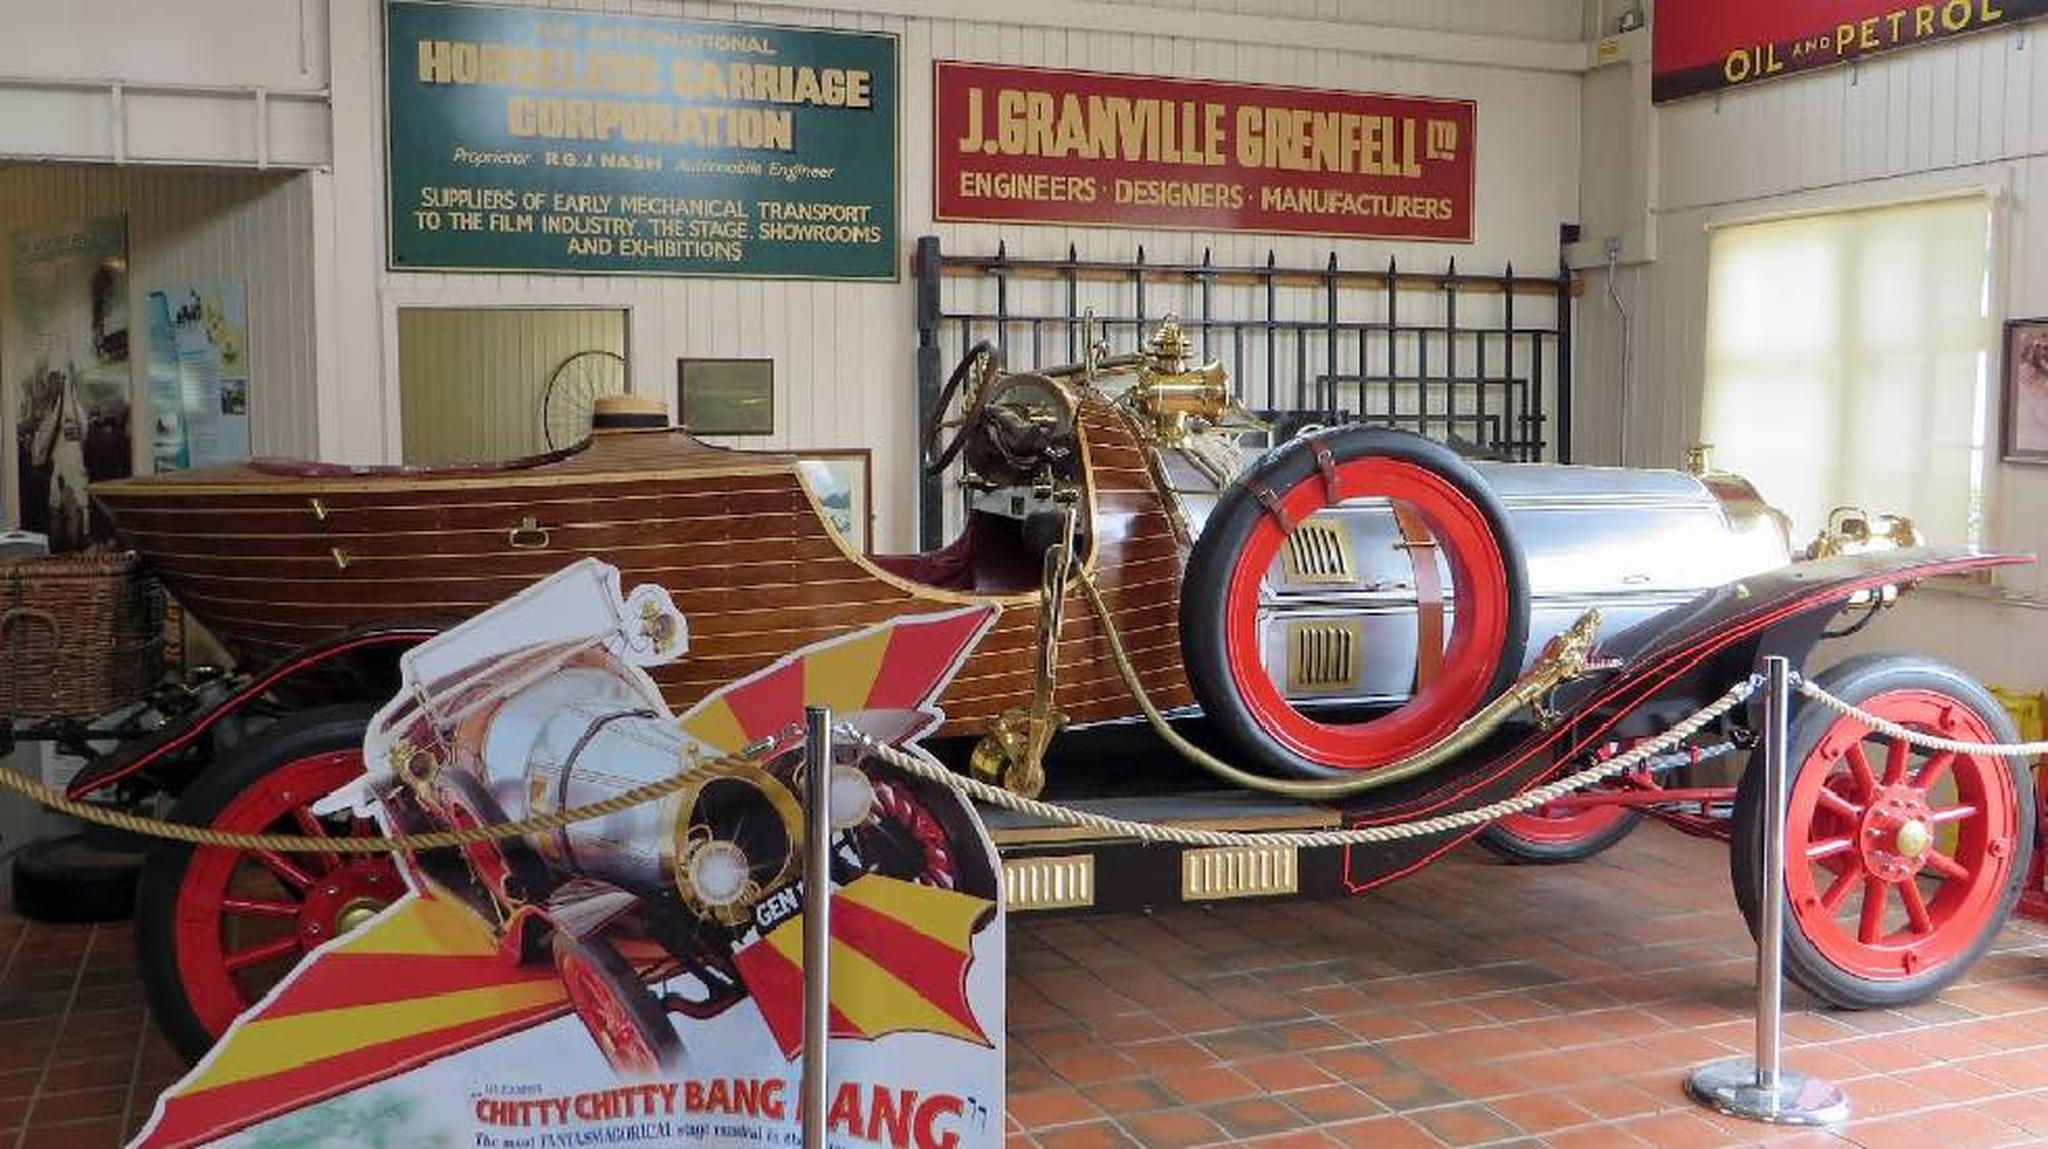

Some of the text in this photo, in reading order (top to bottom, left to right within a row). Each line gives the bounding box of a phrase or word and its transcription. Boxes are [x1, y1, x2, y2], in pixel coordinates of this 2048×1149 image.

[1724, 0, 2003, 83] OIL AND PETROL
[671, 57, 871, 108] CARRIAGE
[507, 96, 793, 151] CORPORATION
[1236, 107, 1422, 179] GRENFELL
[1426, 118, 1458, 162] LTD
[767, 160, 836, 182] Engineer
[421, 186, 872, 223] SUPPLIERS OF EARLY MECHANICAL TRANSPORT
[959, 173, 1453, 221] ENGINEERS DESIGNERS MANUFACTURERS
[413, 210, 441, 231] TO
[447, 211, 484, 232] THE
[489, 213, 534, 233] FILM
[648, 217, 686, 238] THE
[758, 222, 883, 244] SHOWROOMS
[567, 237, 743, 263] AND EXHIBITIONS
[574, 1082, 678, 1122] CHITTY
[684, 1077, 788, 1121] BANG
